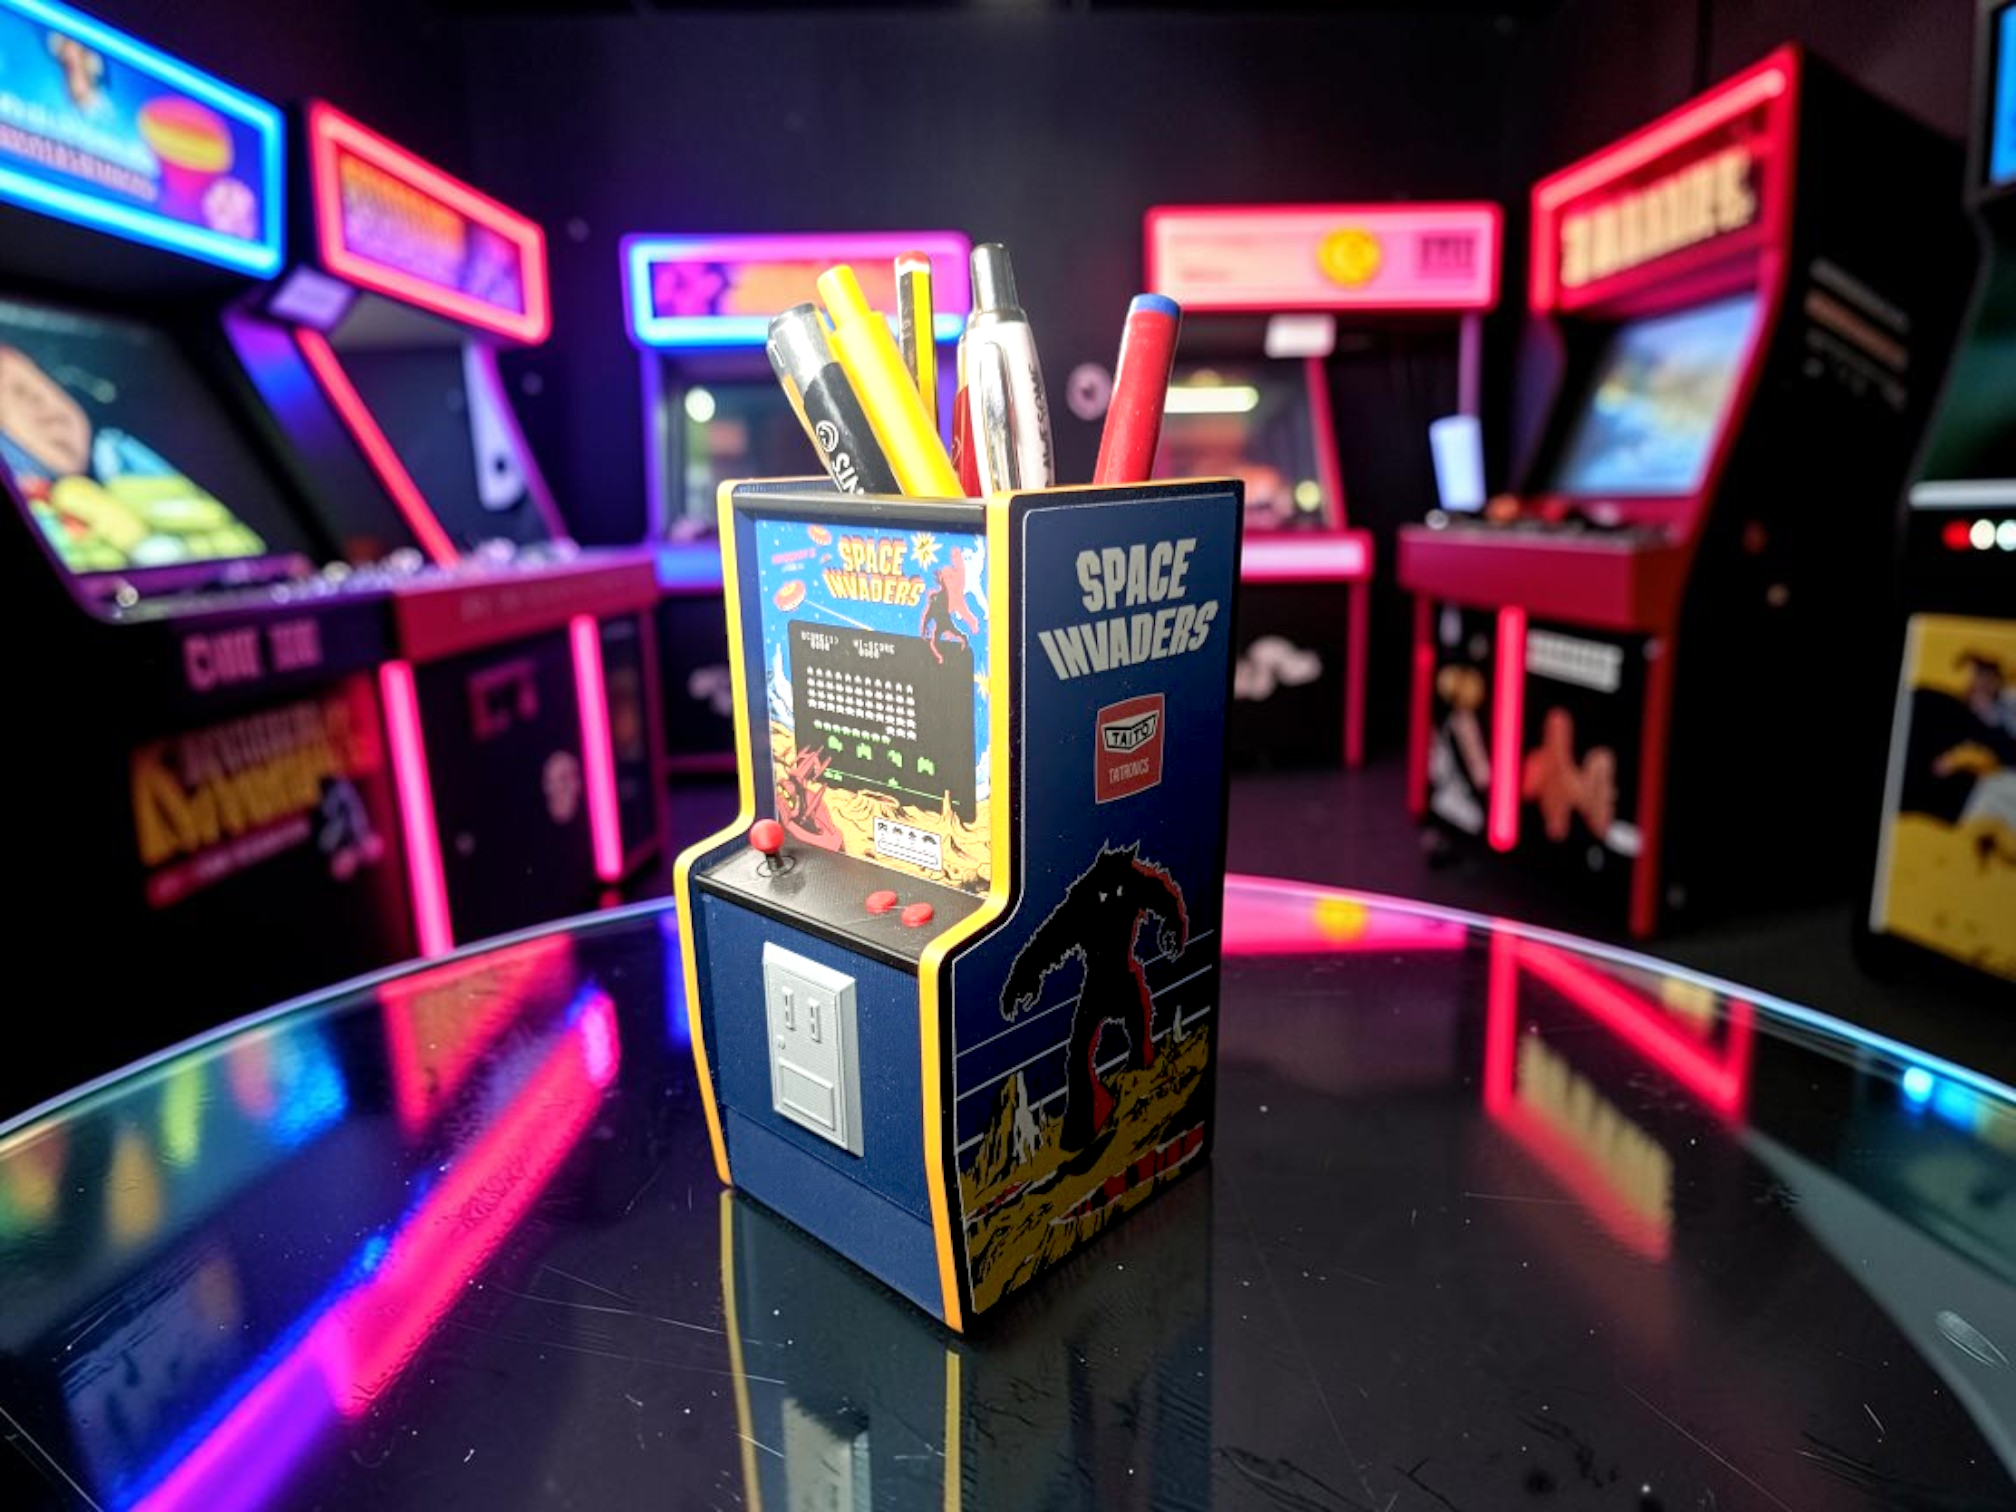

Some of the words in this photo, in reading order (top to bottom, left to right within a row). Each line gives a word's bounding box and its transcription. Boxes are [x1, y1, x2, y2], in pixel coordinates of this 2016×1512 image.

[838, 534, 908, 576] SPACE
[1076, 538, 1197, 613] SPACE
[822, 568, 926, 607] INVADERS
[1037, 599, 1219, 680] INVADERS
[1111, 722, 1150, 746] TAITO
